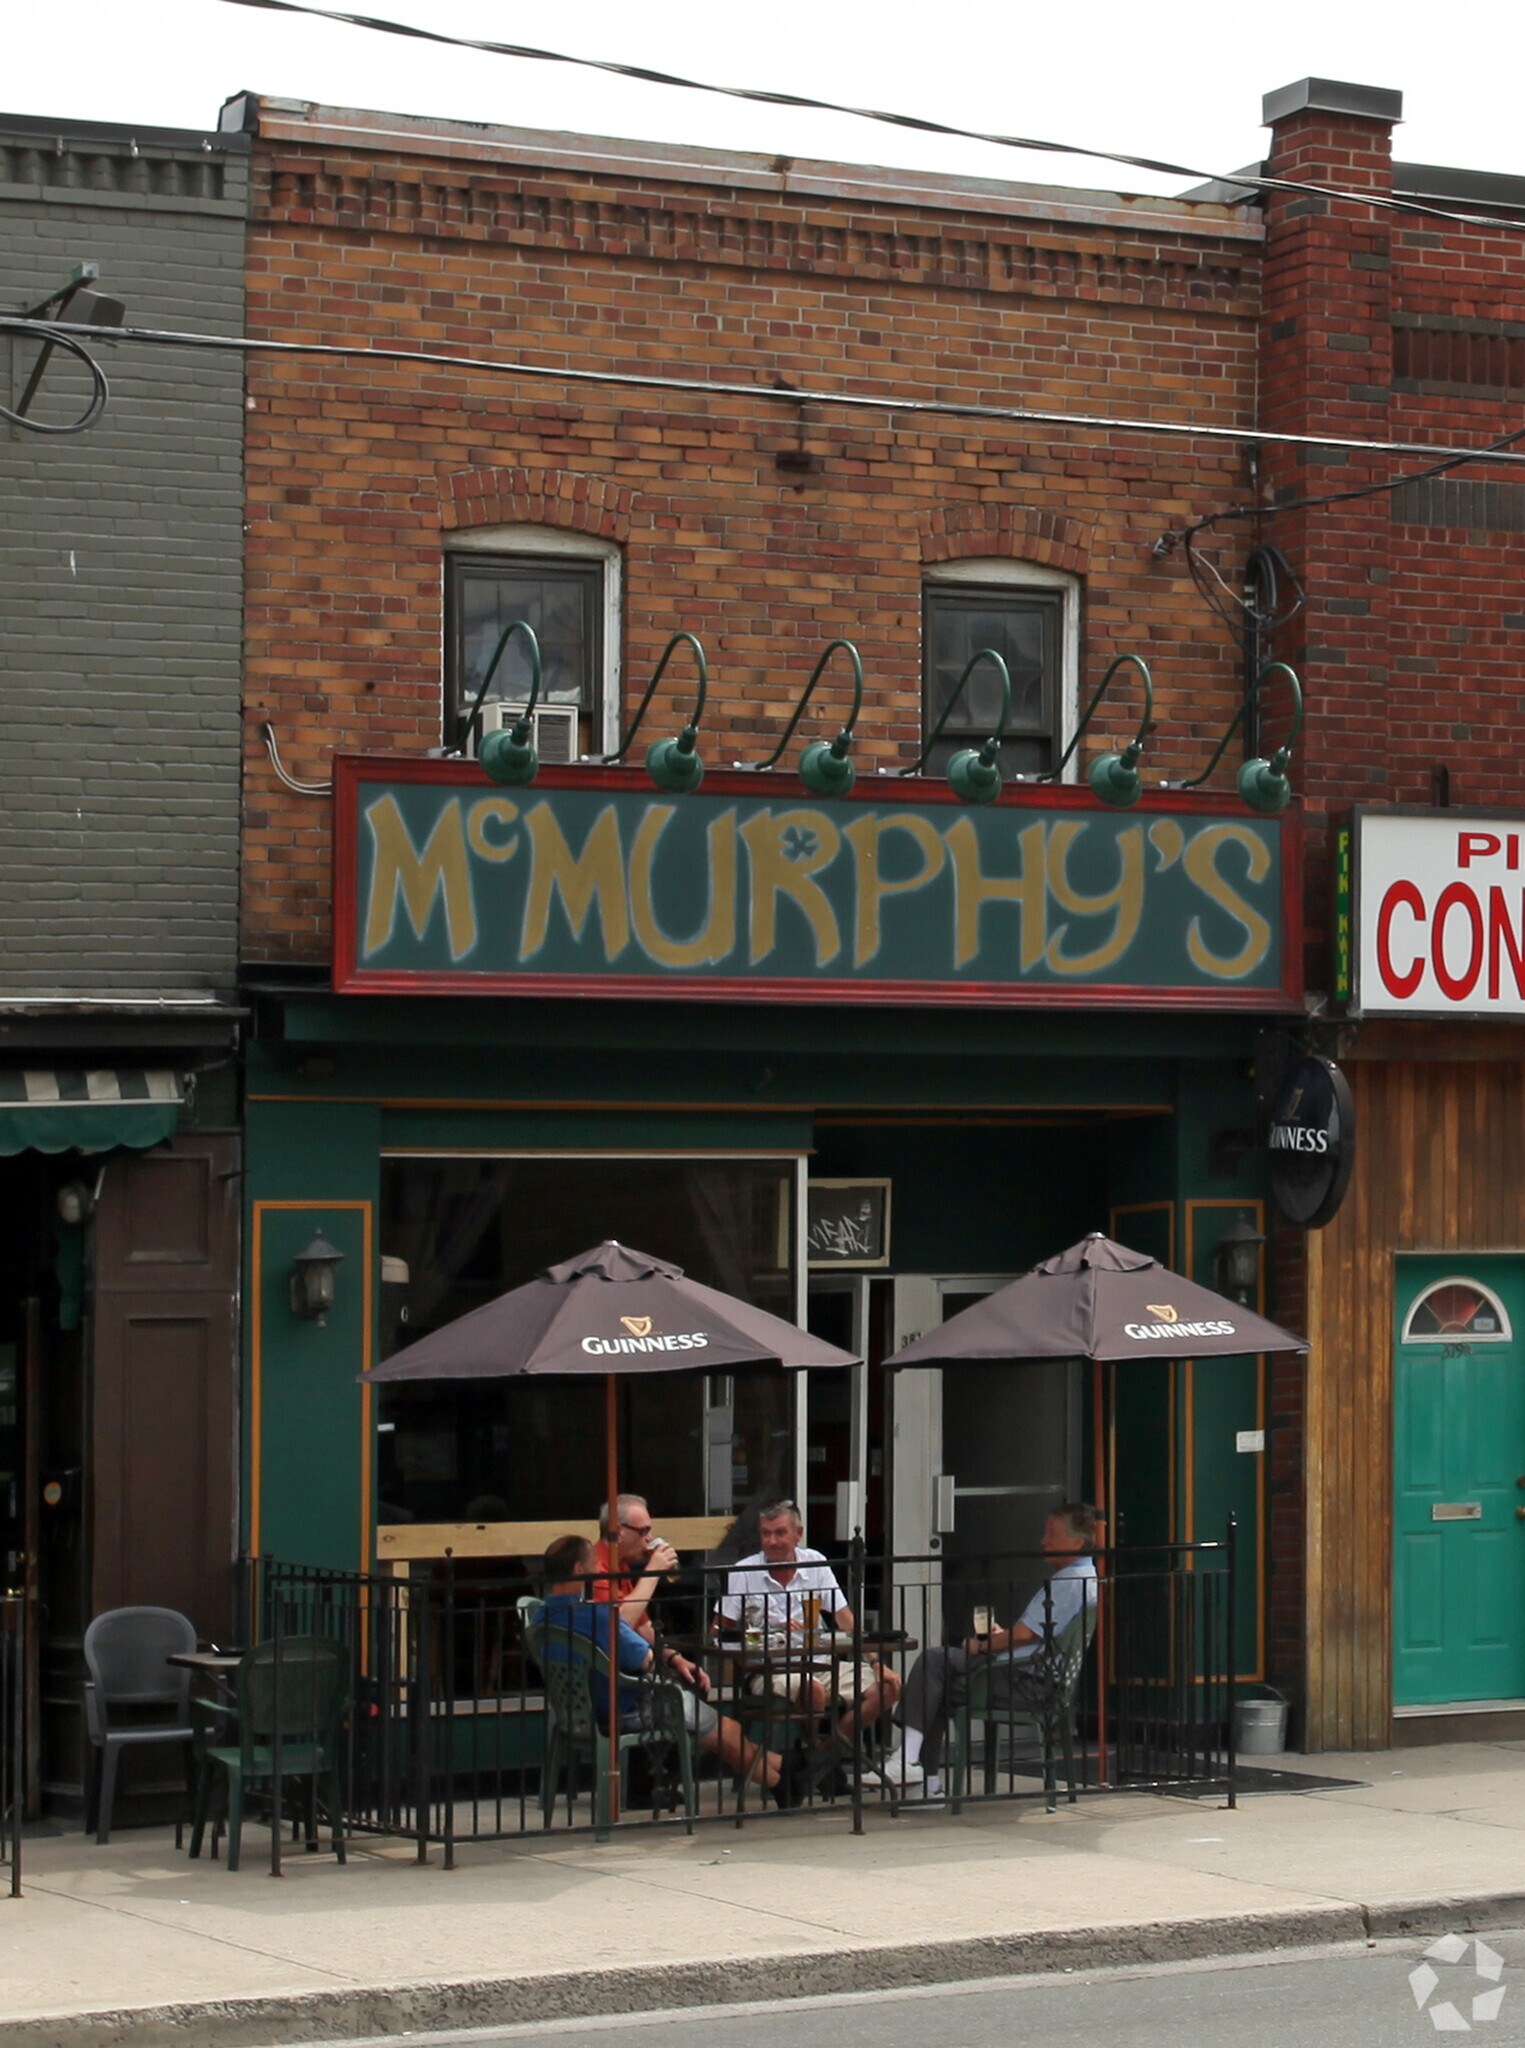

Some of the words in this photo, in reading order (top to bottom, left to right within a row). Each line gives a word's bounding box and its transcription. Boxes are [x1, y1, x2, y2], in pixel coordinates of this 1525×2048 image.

[1457, 832, 1519, 870] PI
[1376, 879, 1525, 1001] CON
[581, 1332, 709, 1355] GUINNESS
[1124, 1320, 1235, 1340] GUINNESS
